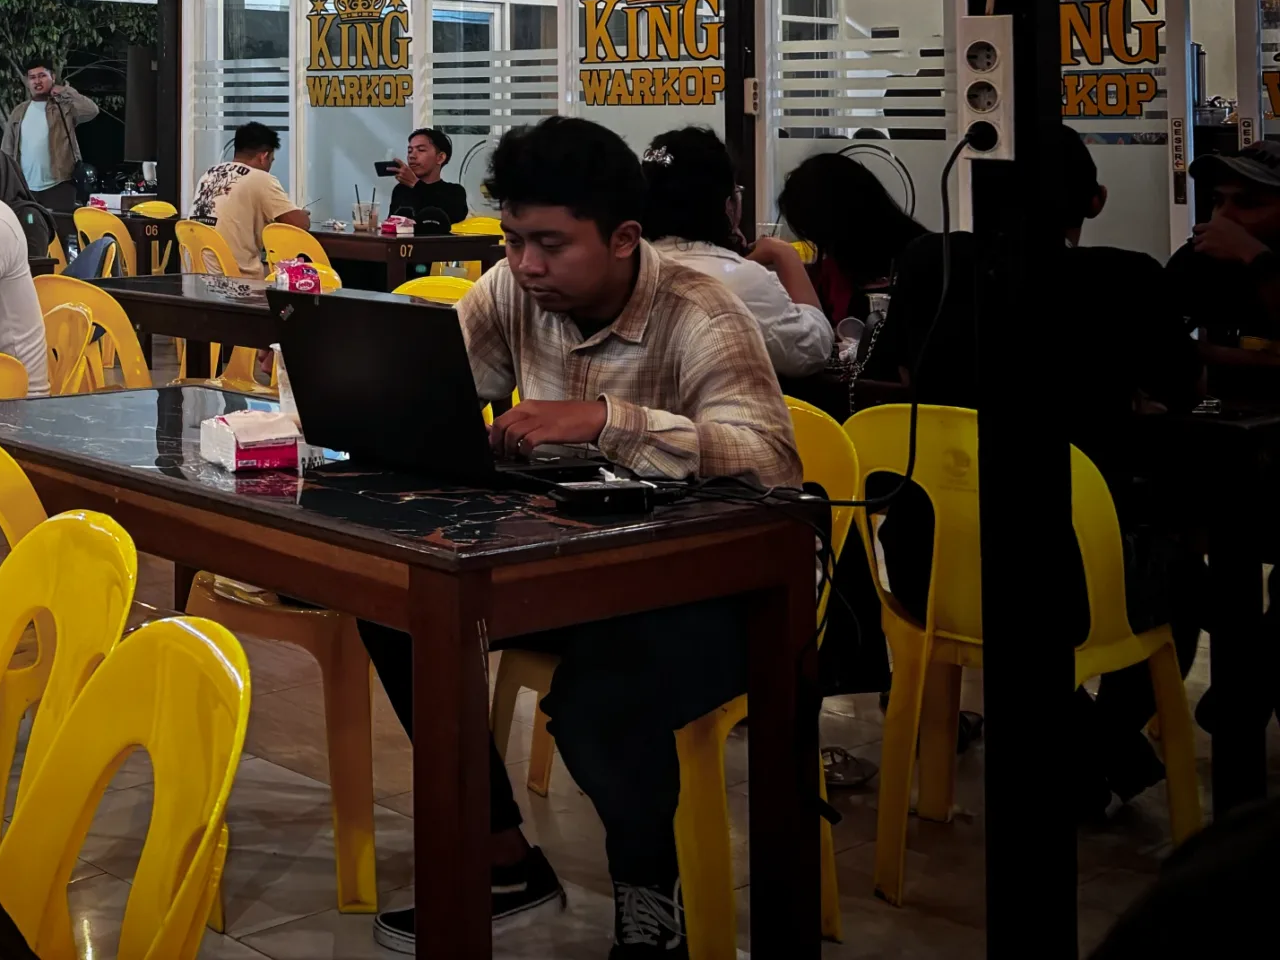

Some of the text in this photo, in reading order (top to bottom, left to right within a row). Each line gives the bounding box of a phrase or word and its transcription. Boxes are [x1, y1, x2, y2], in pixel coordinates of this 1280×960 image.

[306, 10, 413, 71] KING
[306, 74, 413, 107] WARKOP
[580, 66, 726, 105] WARKOP
[1060, 72, 1157, 116] KOP
[1173, 121, 1183, 160] GESER
[1242, 121, 1252, 145] GES
[145, 224, 159, 237] 06
[400, 244, 414, 258] 07
